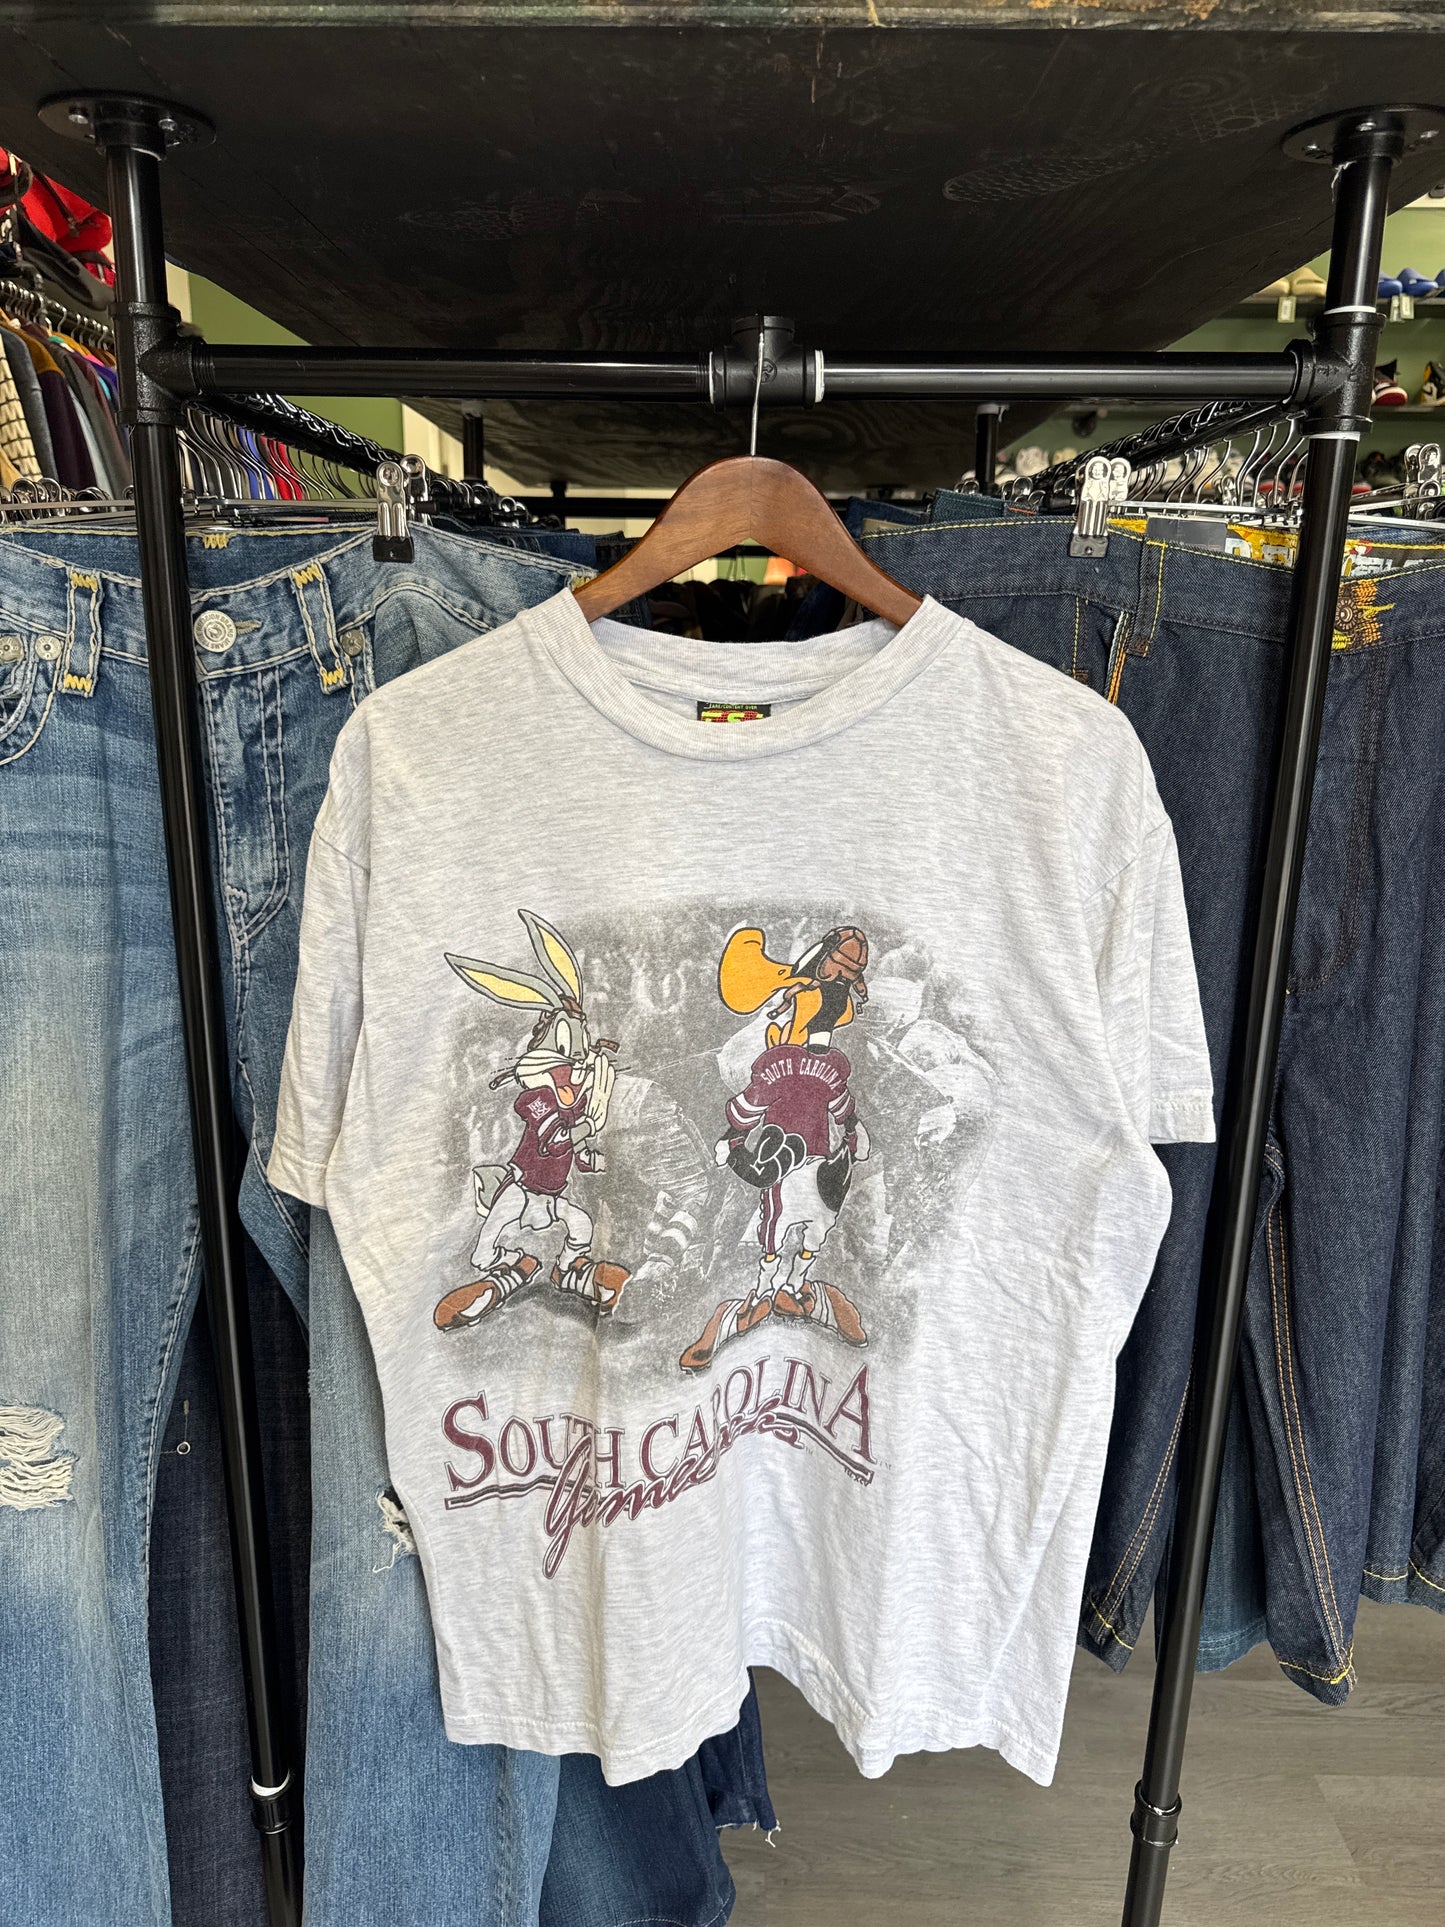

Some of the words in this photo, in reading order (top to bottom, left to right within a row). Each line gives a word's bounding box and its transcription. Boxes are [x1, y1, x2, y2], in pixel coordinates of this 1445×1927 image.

[760, 1058, 793, 1085] SOUTH
[799, 1058, 842, 1090] CAROLINA
[442, 1390, 626, 1491] SOUTH
